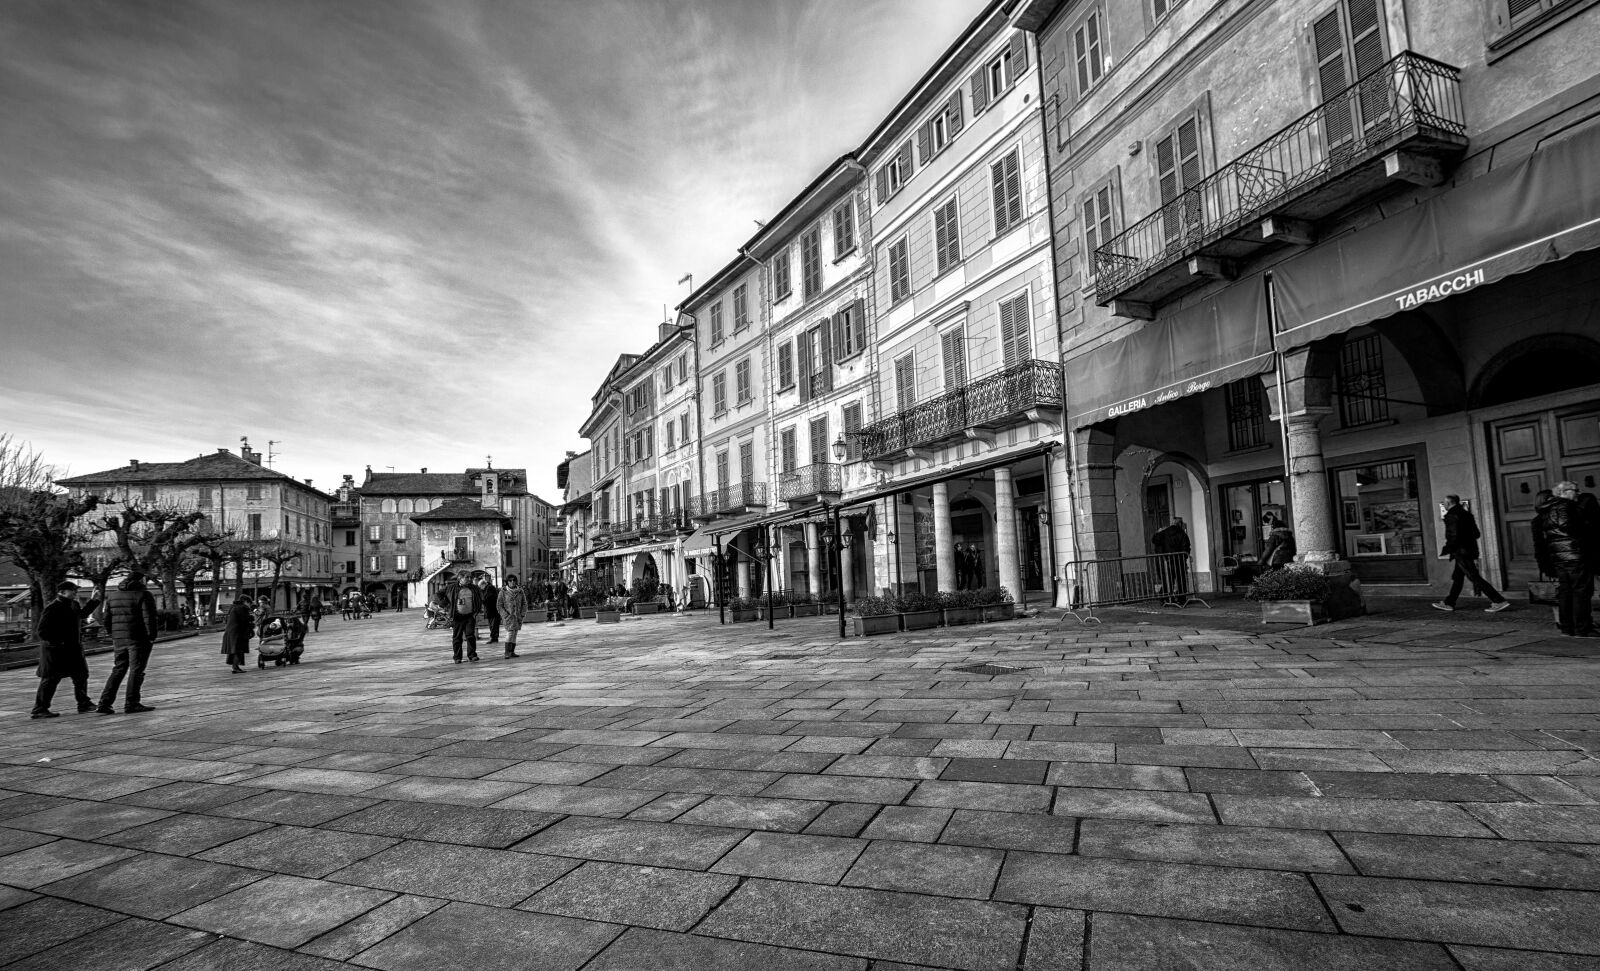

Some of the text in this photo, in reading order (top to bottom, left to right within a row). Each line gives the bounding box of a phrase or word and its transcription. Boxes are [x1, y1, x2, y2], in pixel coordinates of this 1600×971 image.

[1395, 268, 1485, 310] TABACCHI
[1108, 381, 1211, 417] GALLERIA Antico Borgo
